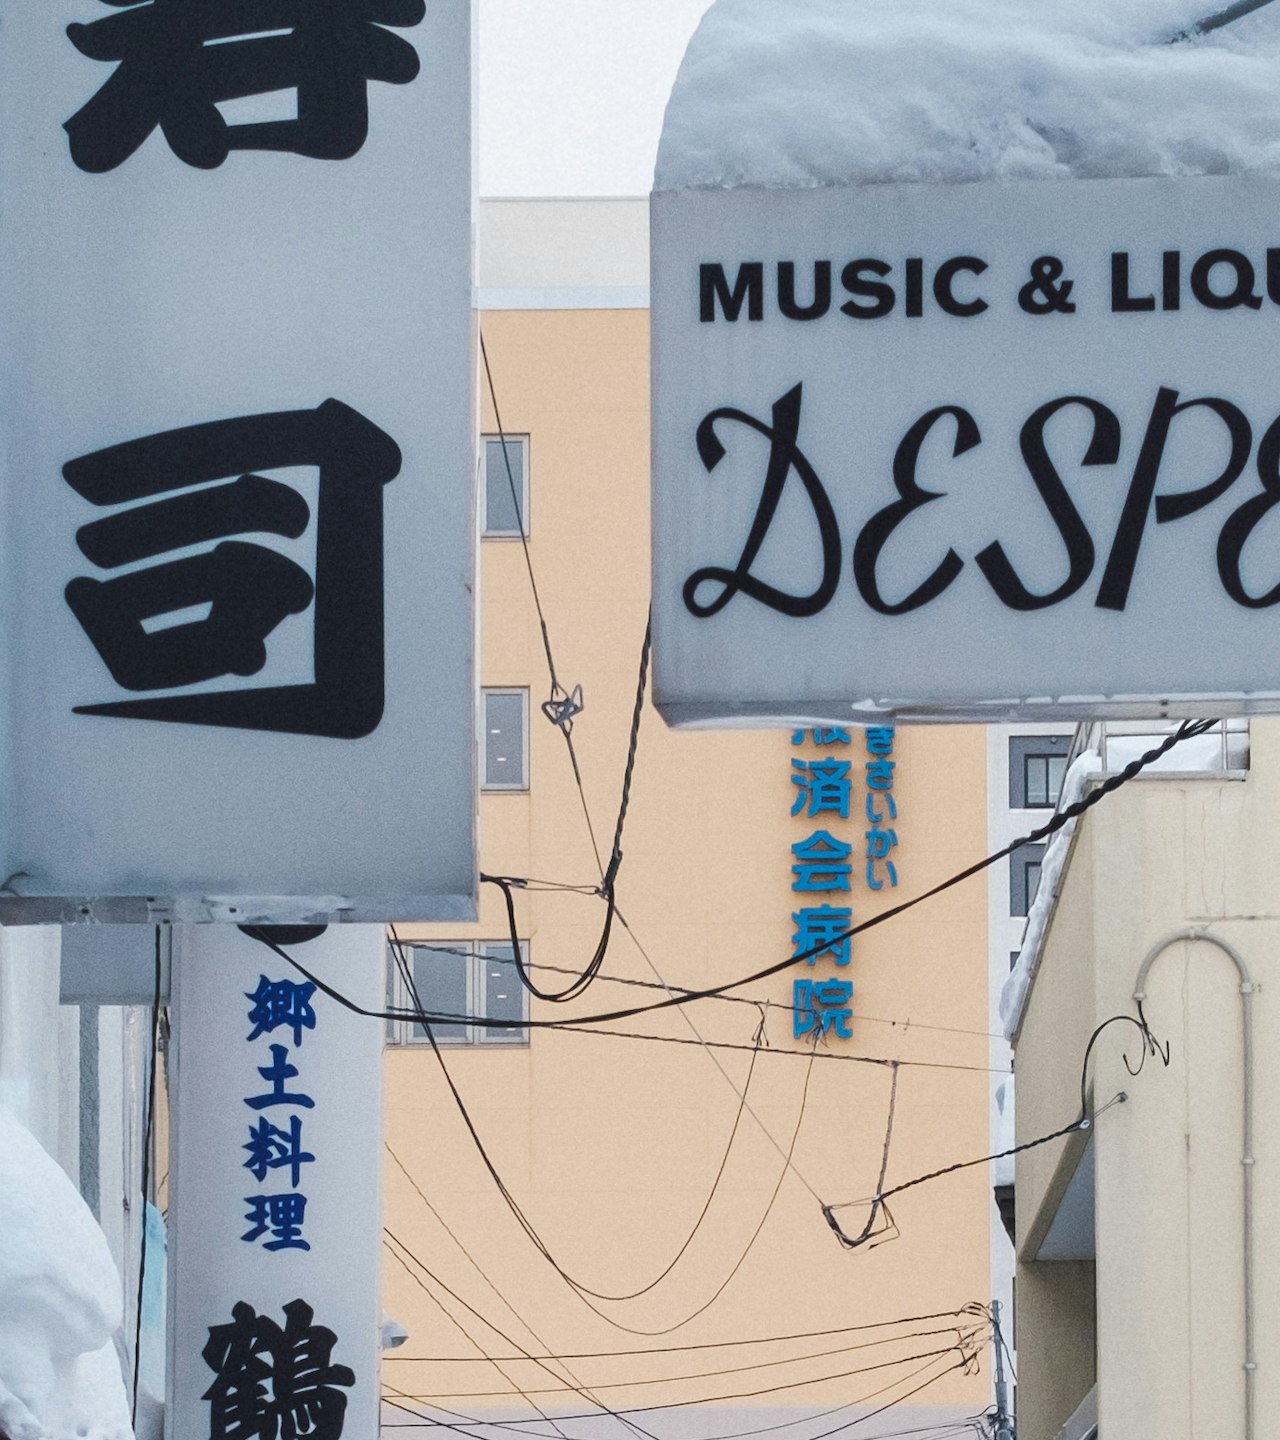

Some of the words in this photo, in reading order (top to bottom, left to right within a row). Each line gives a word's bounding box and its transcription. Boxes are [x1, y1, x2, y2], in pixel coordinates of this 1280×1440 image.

[698, 255, 990, 323] MUSIC
[1017, 255, 1078, 316] &
[242, 974, 317, 1253] 郷土料理
